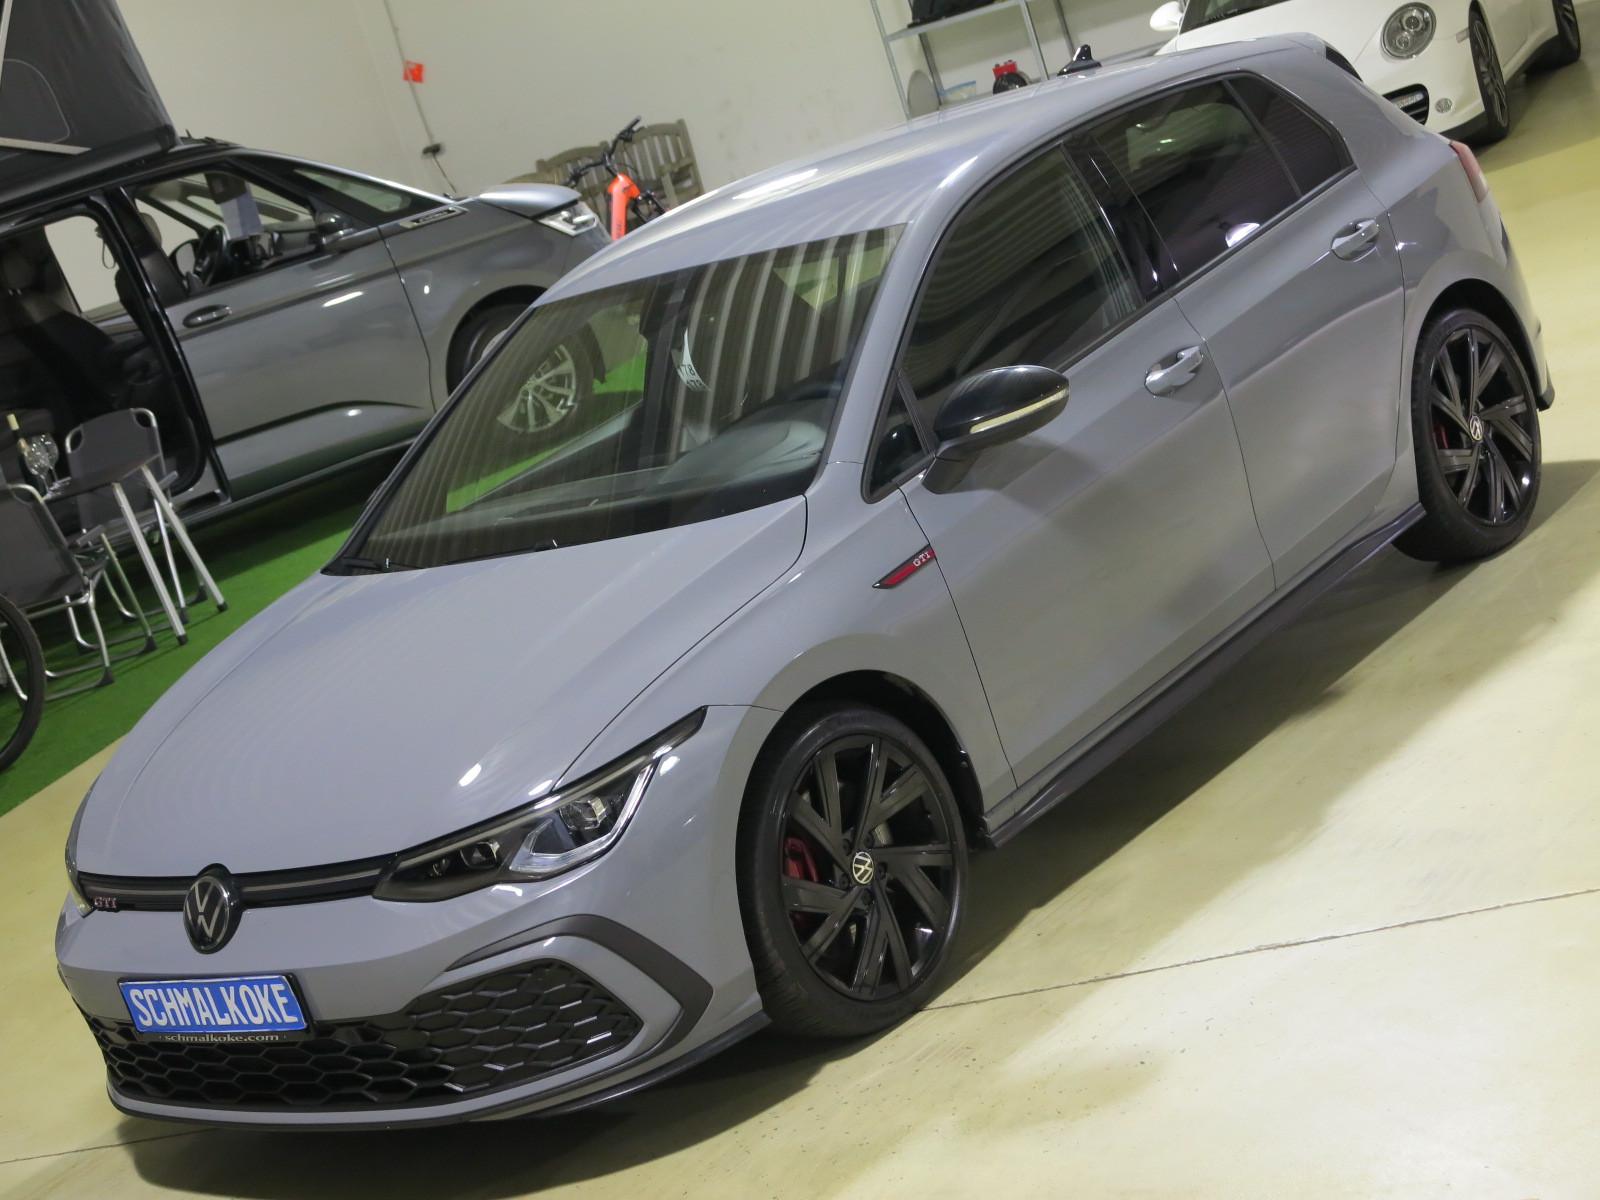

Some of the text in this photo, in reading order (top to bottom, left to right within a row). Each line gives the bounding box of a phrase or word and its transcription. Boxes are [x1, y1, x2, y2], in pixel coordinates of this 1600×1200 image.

[912, 551, 931, 567] GTI
[94, 896, 118, 909] GTI
[129, 984, 298, 1027] SCHMALKOKE
[164, 1033, 280, 1042] schmalkoke.com
